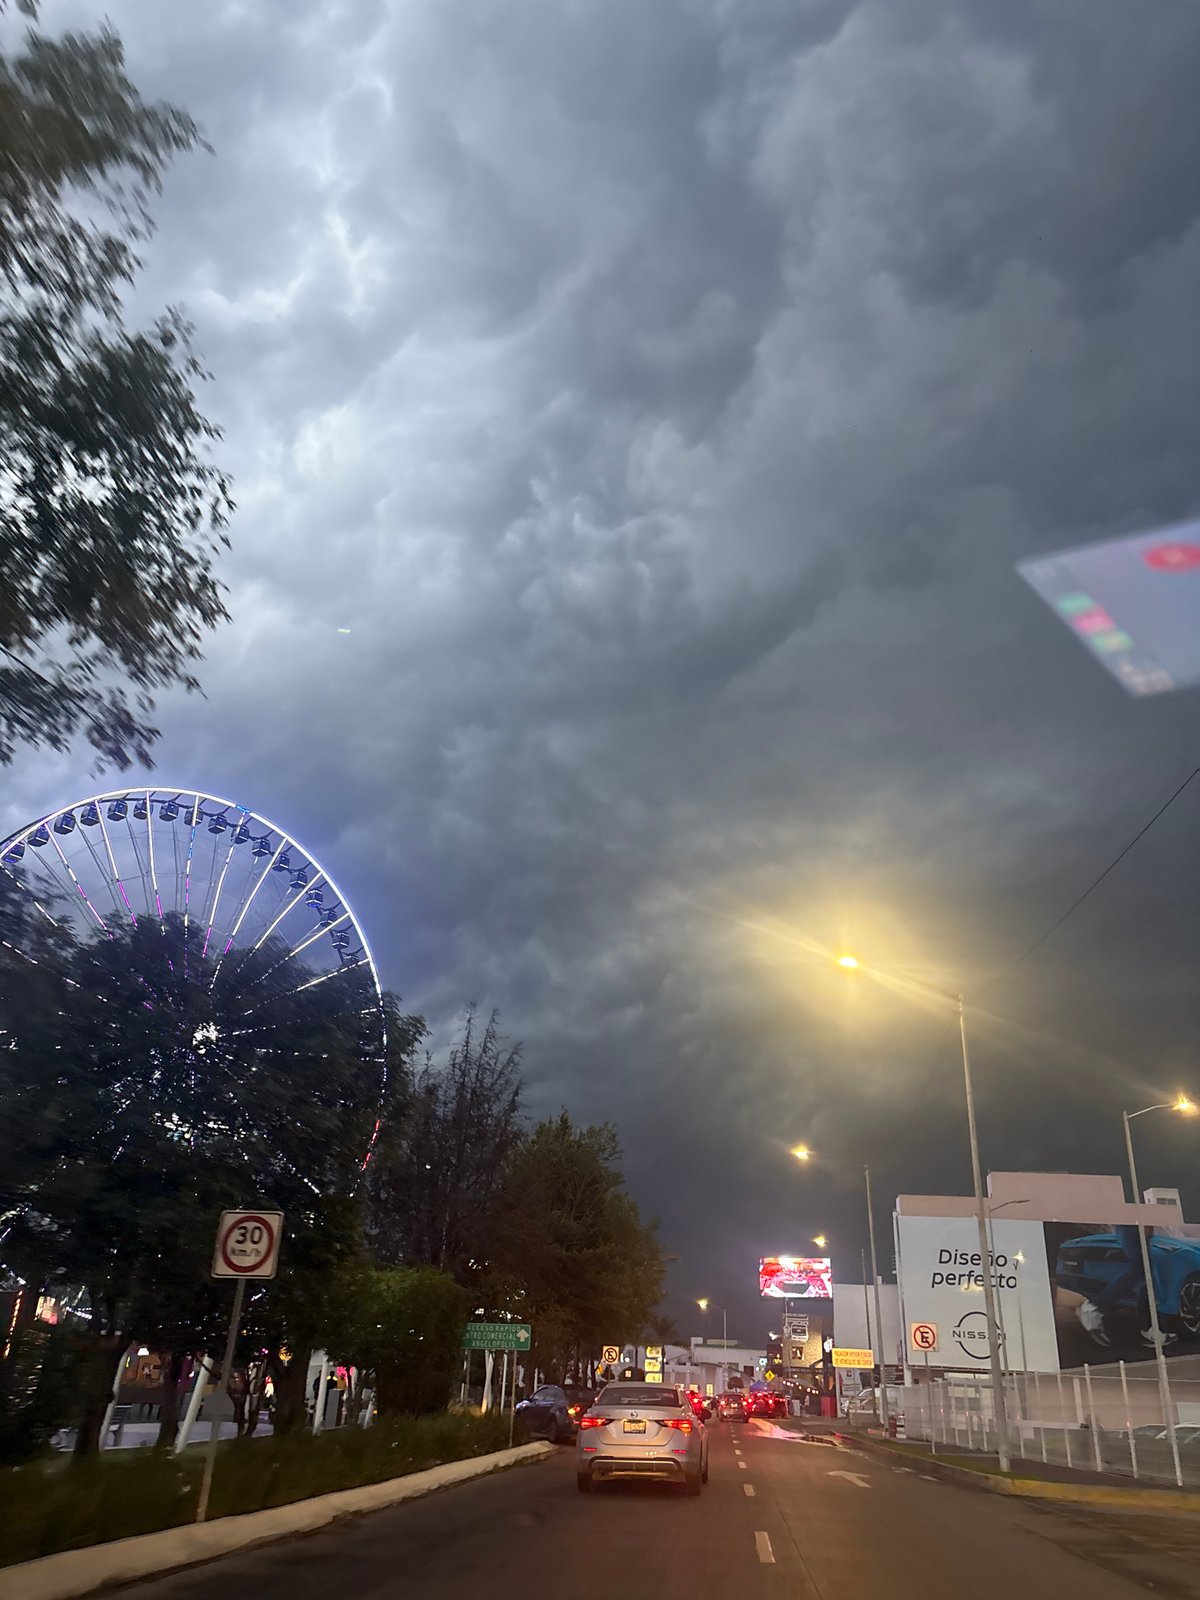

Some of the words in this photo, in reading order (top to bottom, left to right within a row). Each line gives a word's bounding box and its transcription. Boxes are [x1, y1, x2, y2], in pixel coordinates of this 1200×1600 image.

[234, 1225, 262, 1245] 30
[482, 1331, 516, 1341] COMERCIAL
[952, 1330, 1007, 1341] NISSN
[471, 1340, 516, 1348] ANGELOPOLIS
